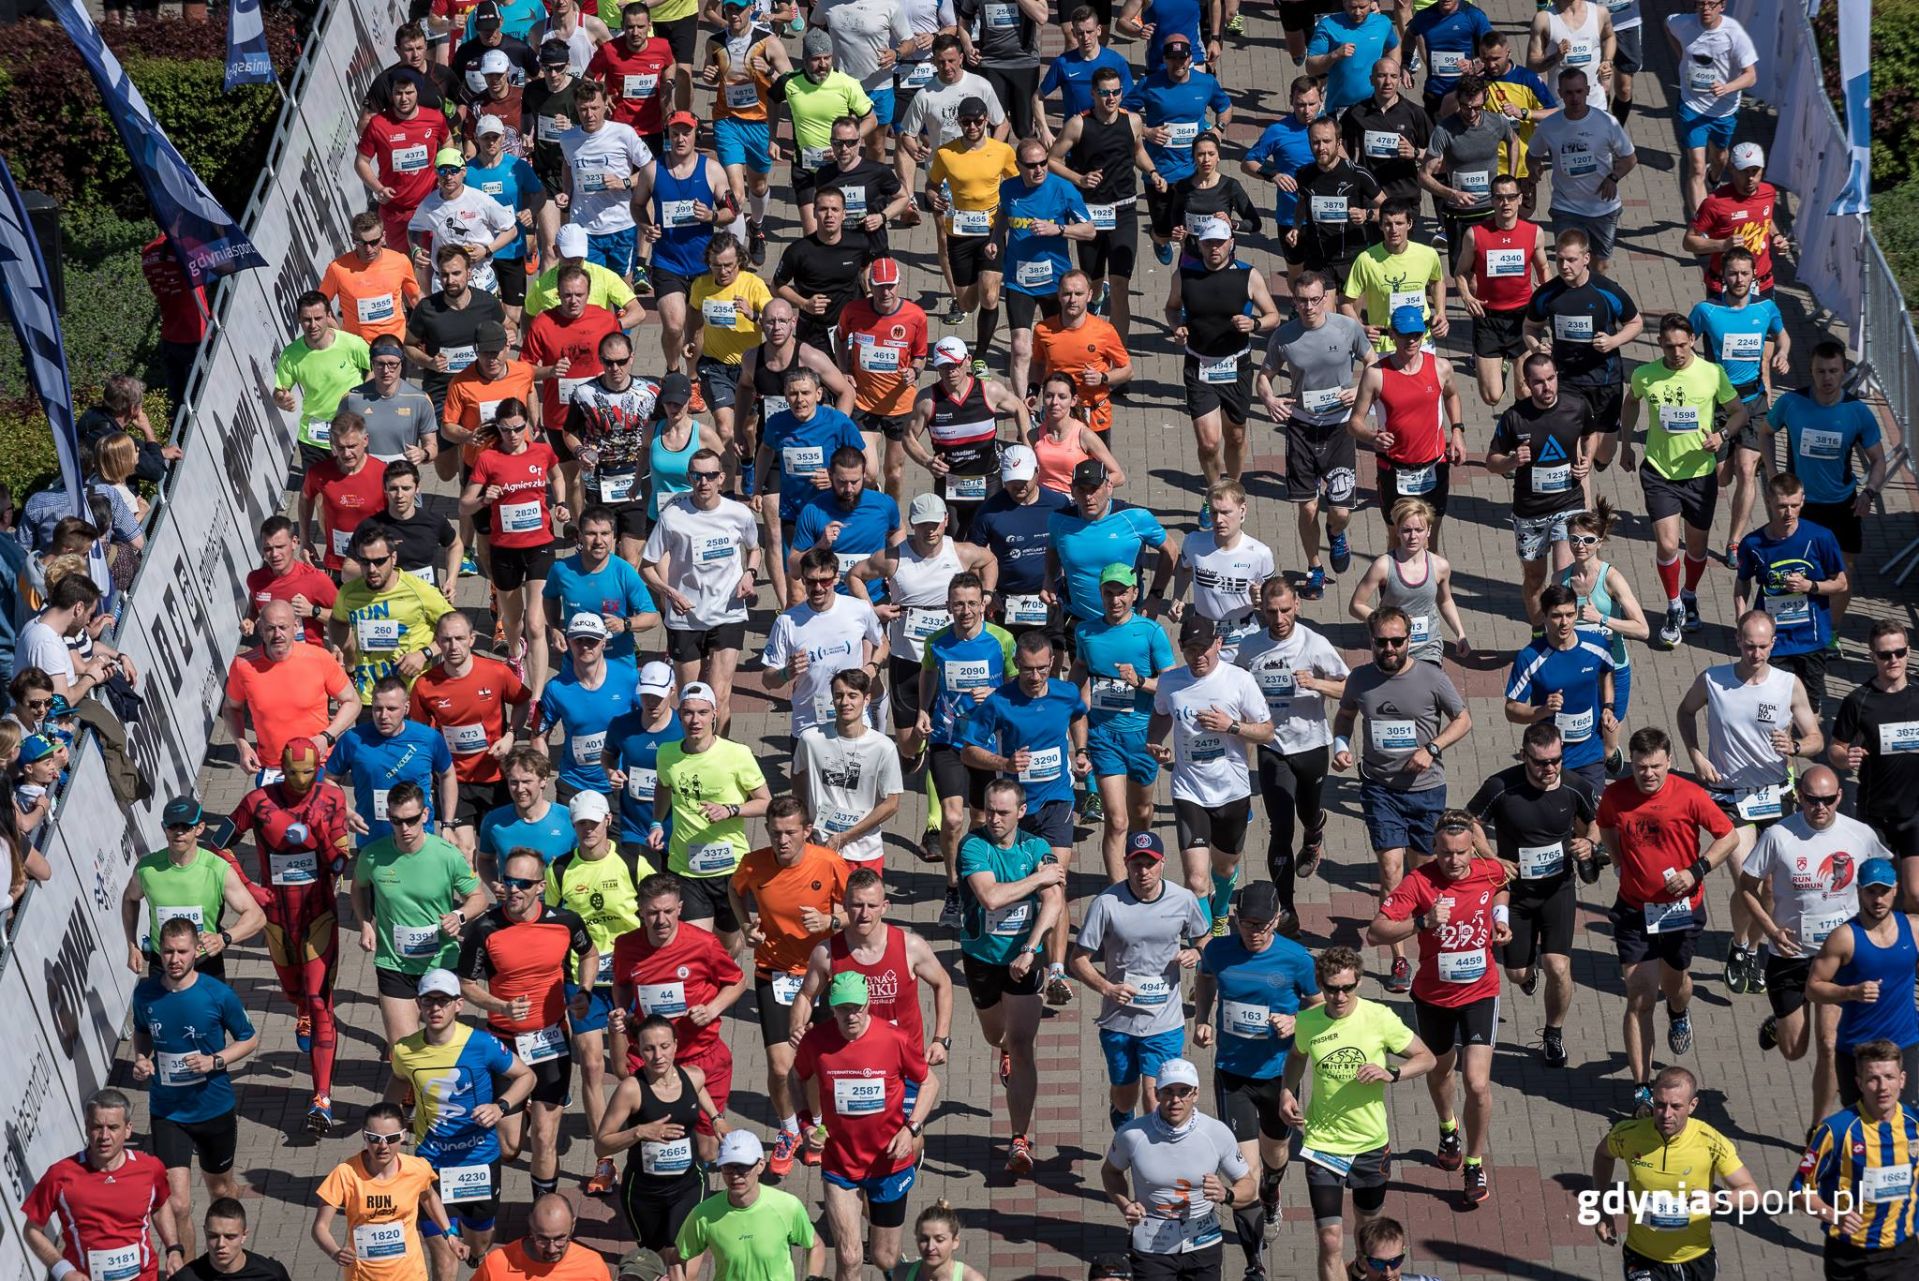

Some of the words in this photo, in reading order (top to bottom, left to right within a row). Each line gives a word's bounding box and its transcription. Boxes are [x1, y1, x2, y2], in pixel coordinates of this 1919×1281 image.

[1175, 128, 1194, 136] 3641
[1376, 137, 1396, 145] 4787
[404, 151, 424, 160] 4373
[1571, 156, 1591, 164] 1207
[1464, 176, 1484, 184] 1891
[1322, 201, 1342, 209] 3879
[1092, 209, 1112, 217] 1925
[188, 241, 256, 277] gdyniasport
[1498, 255, 1522, 263] 4340
[1027, 266, 1050, 274] 3826
[370, 300, 391, 310] 3555
[1405, 297, 1421, 305] 354
[711, 306, 734, 314] 2354
[1566, 321, 1587, 329] 2381
[1736, 338, 1758, 347] 2246
[872, 352, 896, 361] 4613
[1672, 411, 1695, 420] 1598
[795, 453, 820, 461] 3535
[514, 507, 538, 517] 2820
[705, 537, 730, 548] 2580
[920, 616, 945, 627] 2332
[374, 626, 391, 635] 260
[958, 667, 985, 676] 2090
[1263, 675, 1287, 684] 2376
[1570, 715, 1591, 727] 1602
[458, 731, 478, 740] 473
[1385, 726, 1410, 736] 3051
[1193, 738, 1220, 749] 2479
[1032, 754, 1058, 767] 3290
[833, 811, 860, 823] 3376
[702, 847, 730, 858] 3373
[1535, 849, 1560, 862] 1765
[286, 859, 312, 868] 4262
[1817, 918, 1844, 930] 1719
[1454, 956, 1482, 967] 4459
[1139, 982, 1166, 992] 4947
[659, 990, 674, 999] 44
[1239, 1011, 1261, 1021] 163
[1310, 1033, 1339, 1047] FINISHER
[851, 1085, 881, 1096] 2587
[658, 1146, 687, 1157] 2665
[457, 1171, 486, 1183] 4230
[1879, 1171, 1906, 1183] 1662
[366, 1194, 393, 1209] RUN
[370, 1229, 400, 1242] 1820
[107, 1252, 135, 1267] 3181
